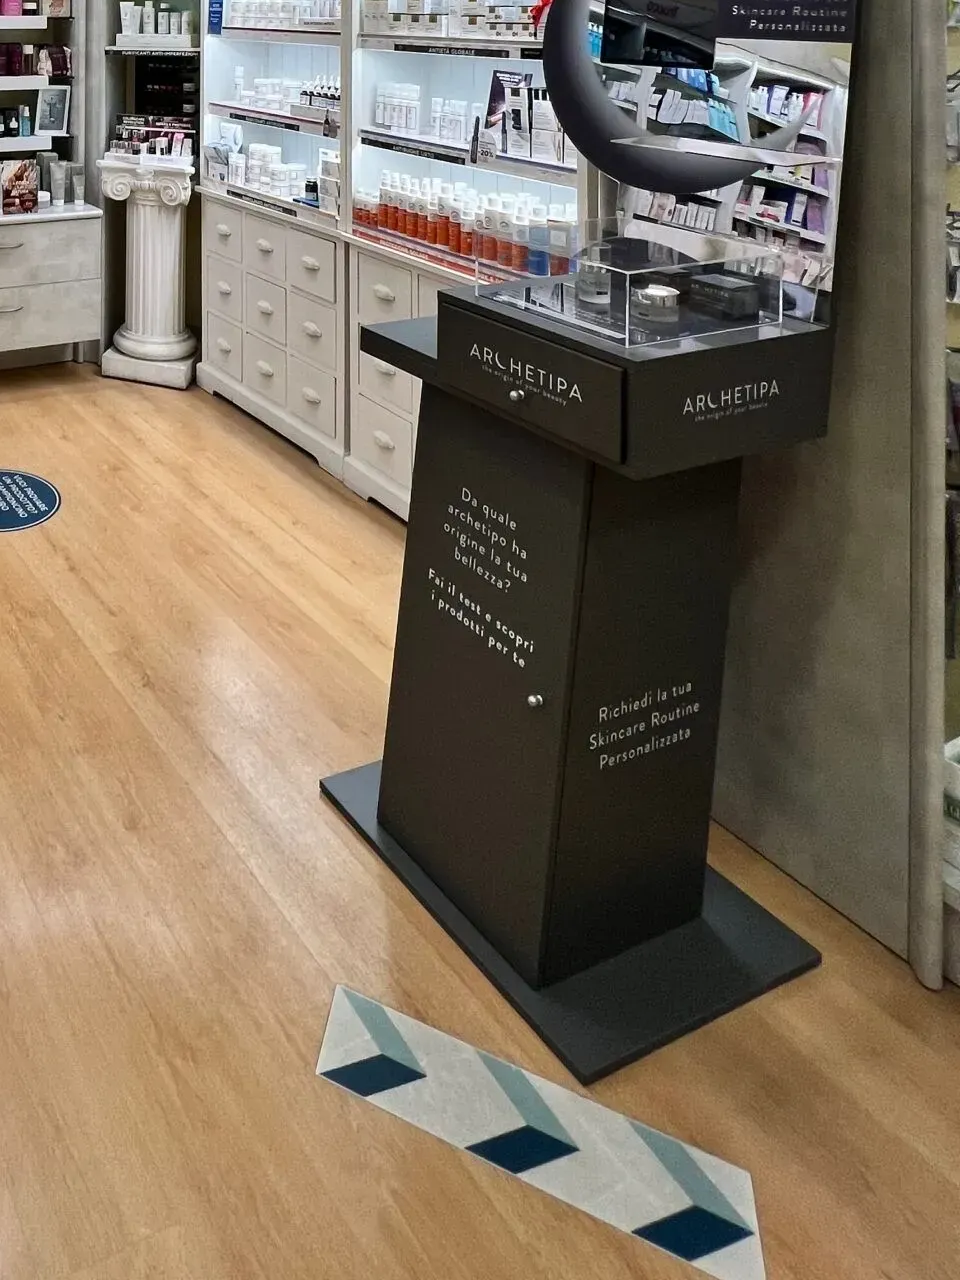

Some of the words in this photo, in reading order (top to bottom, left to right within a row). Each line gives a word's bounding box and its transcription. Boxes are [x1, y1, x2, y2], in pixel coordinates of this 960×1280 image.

[469, 343, 583, 403] ARCHETIPA
[682, 379, 780, 415] ARCHETIPA
[447, 504, 507, 547] archetipo
[511, 539, 527, 560] ha
[461, 487, 478, 508] Da
[482, 504, 517, 531] quale
[443, 522, 486, 555] origine
[490, 548, 501, 566] la
[506, 561, 528, 583] tua
[454, 546, 511, 593] bellezza?
[428, 568, 445, 589] Fai
[448, 582, 456, 596] il
[459, 592, 481, 616] test
[485, 612, 492, 623] e
[495, 619, 534, 653] scopri
[431, 589, 436, 601] i
[438, 598, 485, 637] prodotti
[488, 635, 509, 655] per
[512, 651, 526, 668] te
[589, 722, 646, 750] Skincare
[651, 702, 700, 728] Routine
[599, 690, 652, 723] Richiedi
[657, 687, 667, 703] la
[672, 682, 692, 697] tua
[599, 728, 691, 770] Personalizzata
